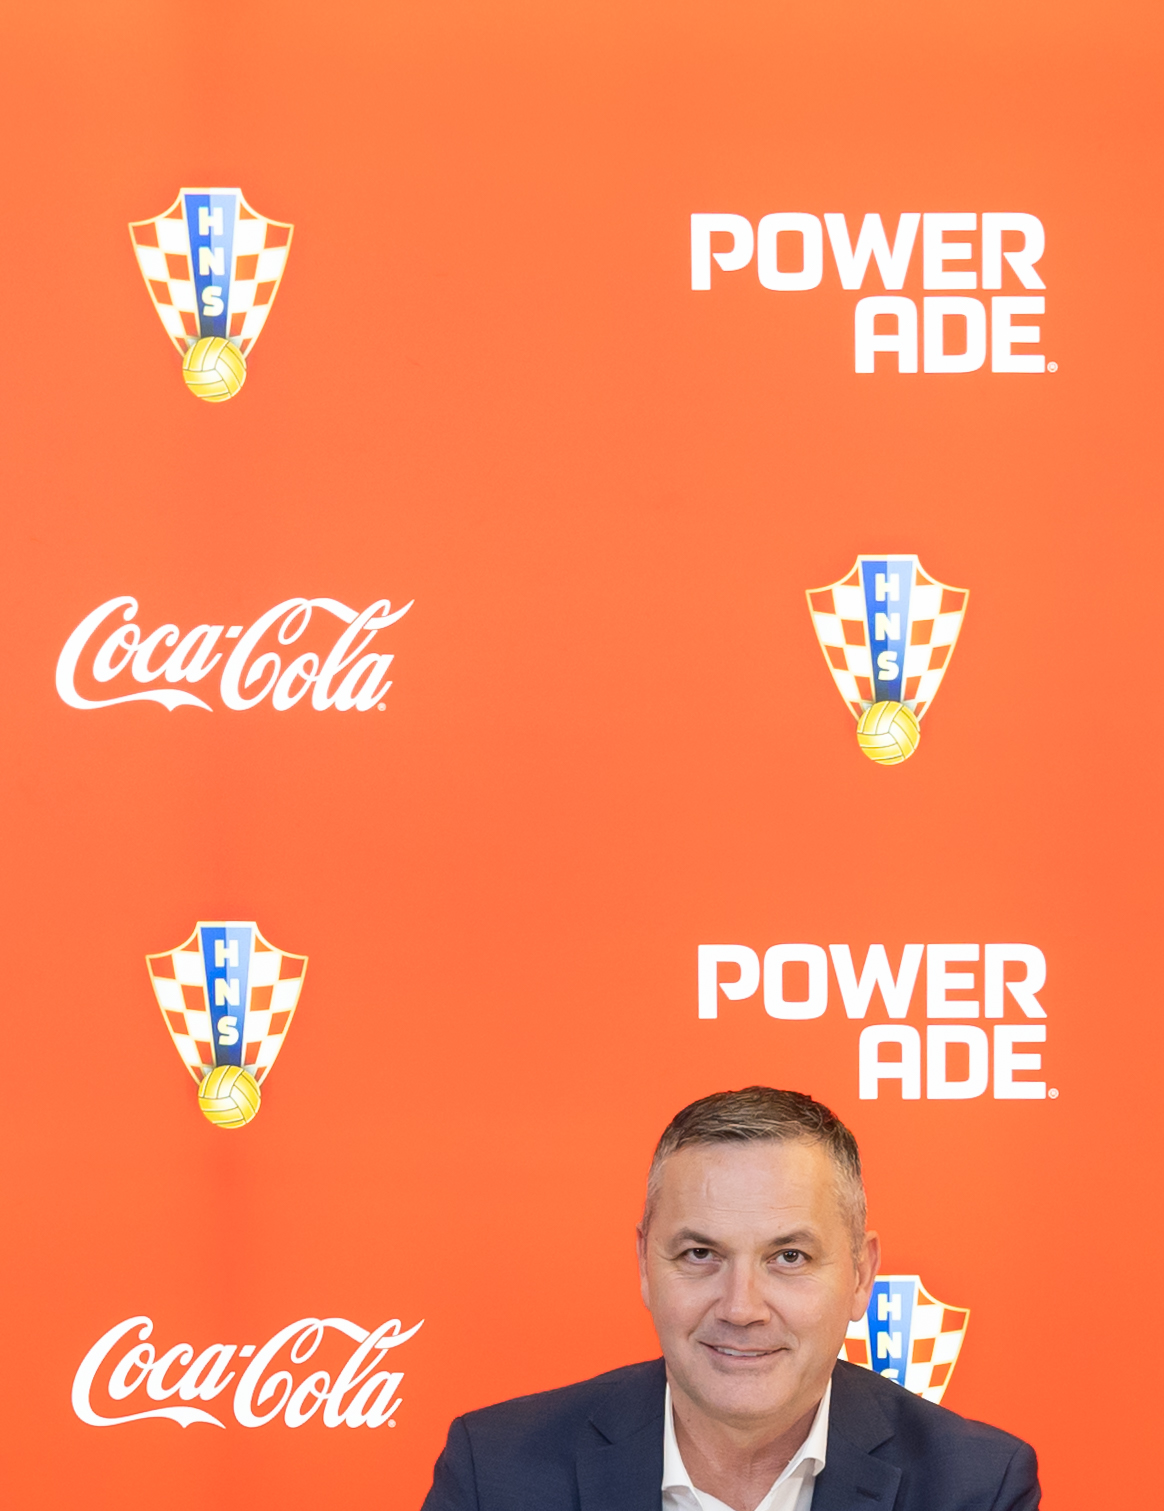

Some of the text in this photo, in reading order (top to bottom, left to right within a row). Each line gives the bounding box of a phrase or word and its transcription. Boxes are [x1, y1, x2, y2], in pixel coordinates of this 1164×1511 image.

[198, 207, 224, 317] HNS
[690, 212, 1047, 290] POWER
[854, 296, 1047, 373] ADE
[55, 595, 414, 712] Coca-Cola
[874, 573, 900, 681] HNS
[214, 939, 240, 1046] HNS
[697, 943, 1048, 1020] POWER
[858, 1024, 1048, 1100] ADE
[71, 1315, 425, 1429] Coca-Cola
